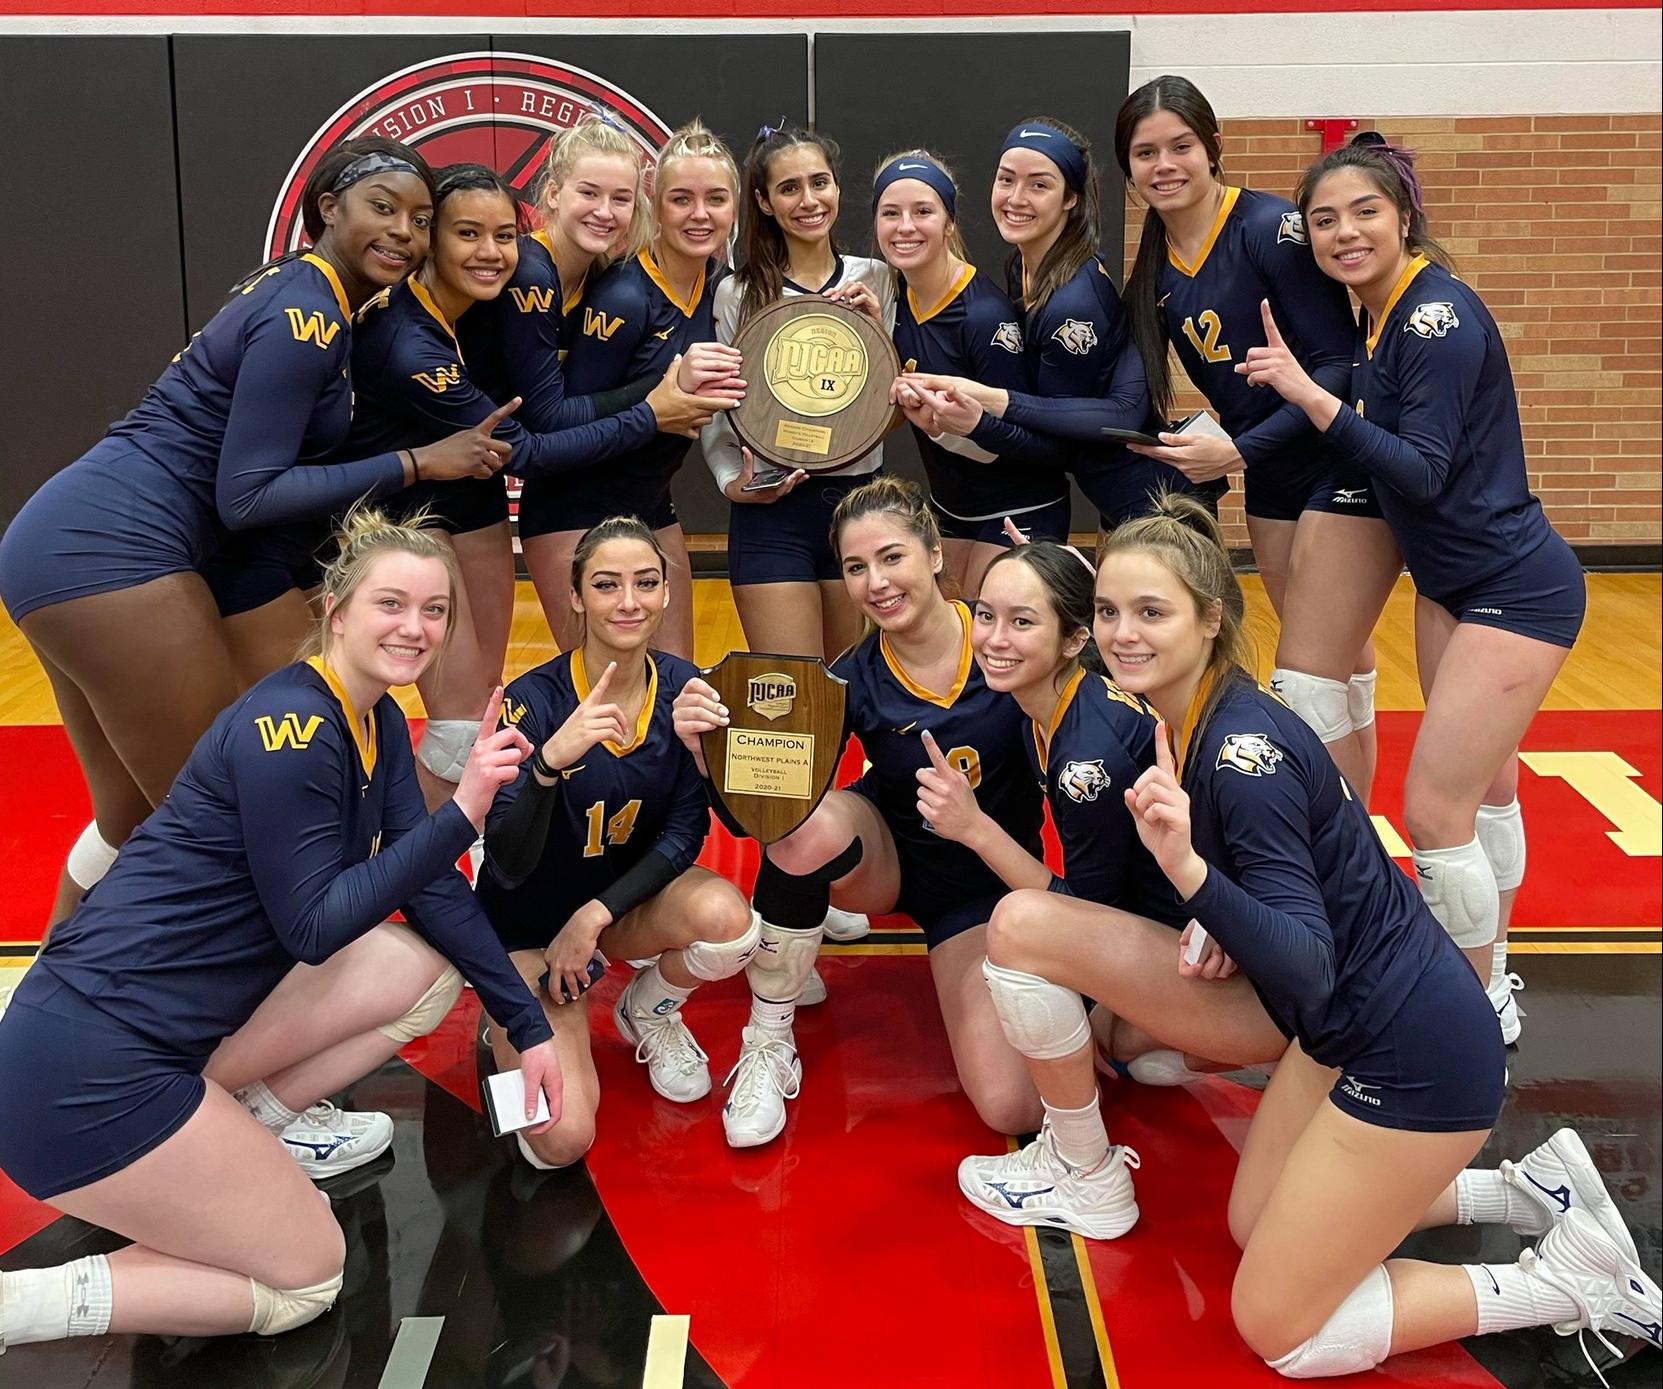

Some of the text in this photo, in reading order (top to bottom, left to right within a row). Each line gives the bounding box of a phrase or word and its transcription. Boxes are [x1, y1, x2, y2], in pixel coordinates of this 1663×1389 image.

[464, 90, 475, 110] I
[284, 308, 341, 350] W
[583, 307, 625, 341] W
[1181, 309, 1232, 363] 12
[776, 340, 861, 379] NJCAA
[820, 379, 836, 391] IX
[748, 682, 795, 704] NJCAA
[254, 713, 325, 752] W
[737, 734, 804, 750] CHAMPION
[731, 752, 774, 763] NORTHWEST
[776, 757, 801, 766] PLAINS
[751, 767, 788, 775] VOLLEYBALL
[753, 773, 780, 781] DIVISION
[754, 783, 782, 791] 2020-21
[583, 799, 642, 857] 14
